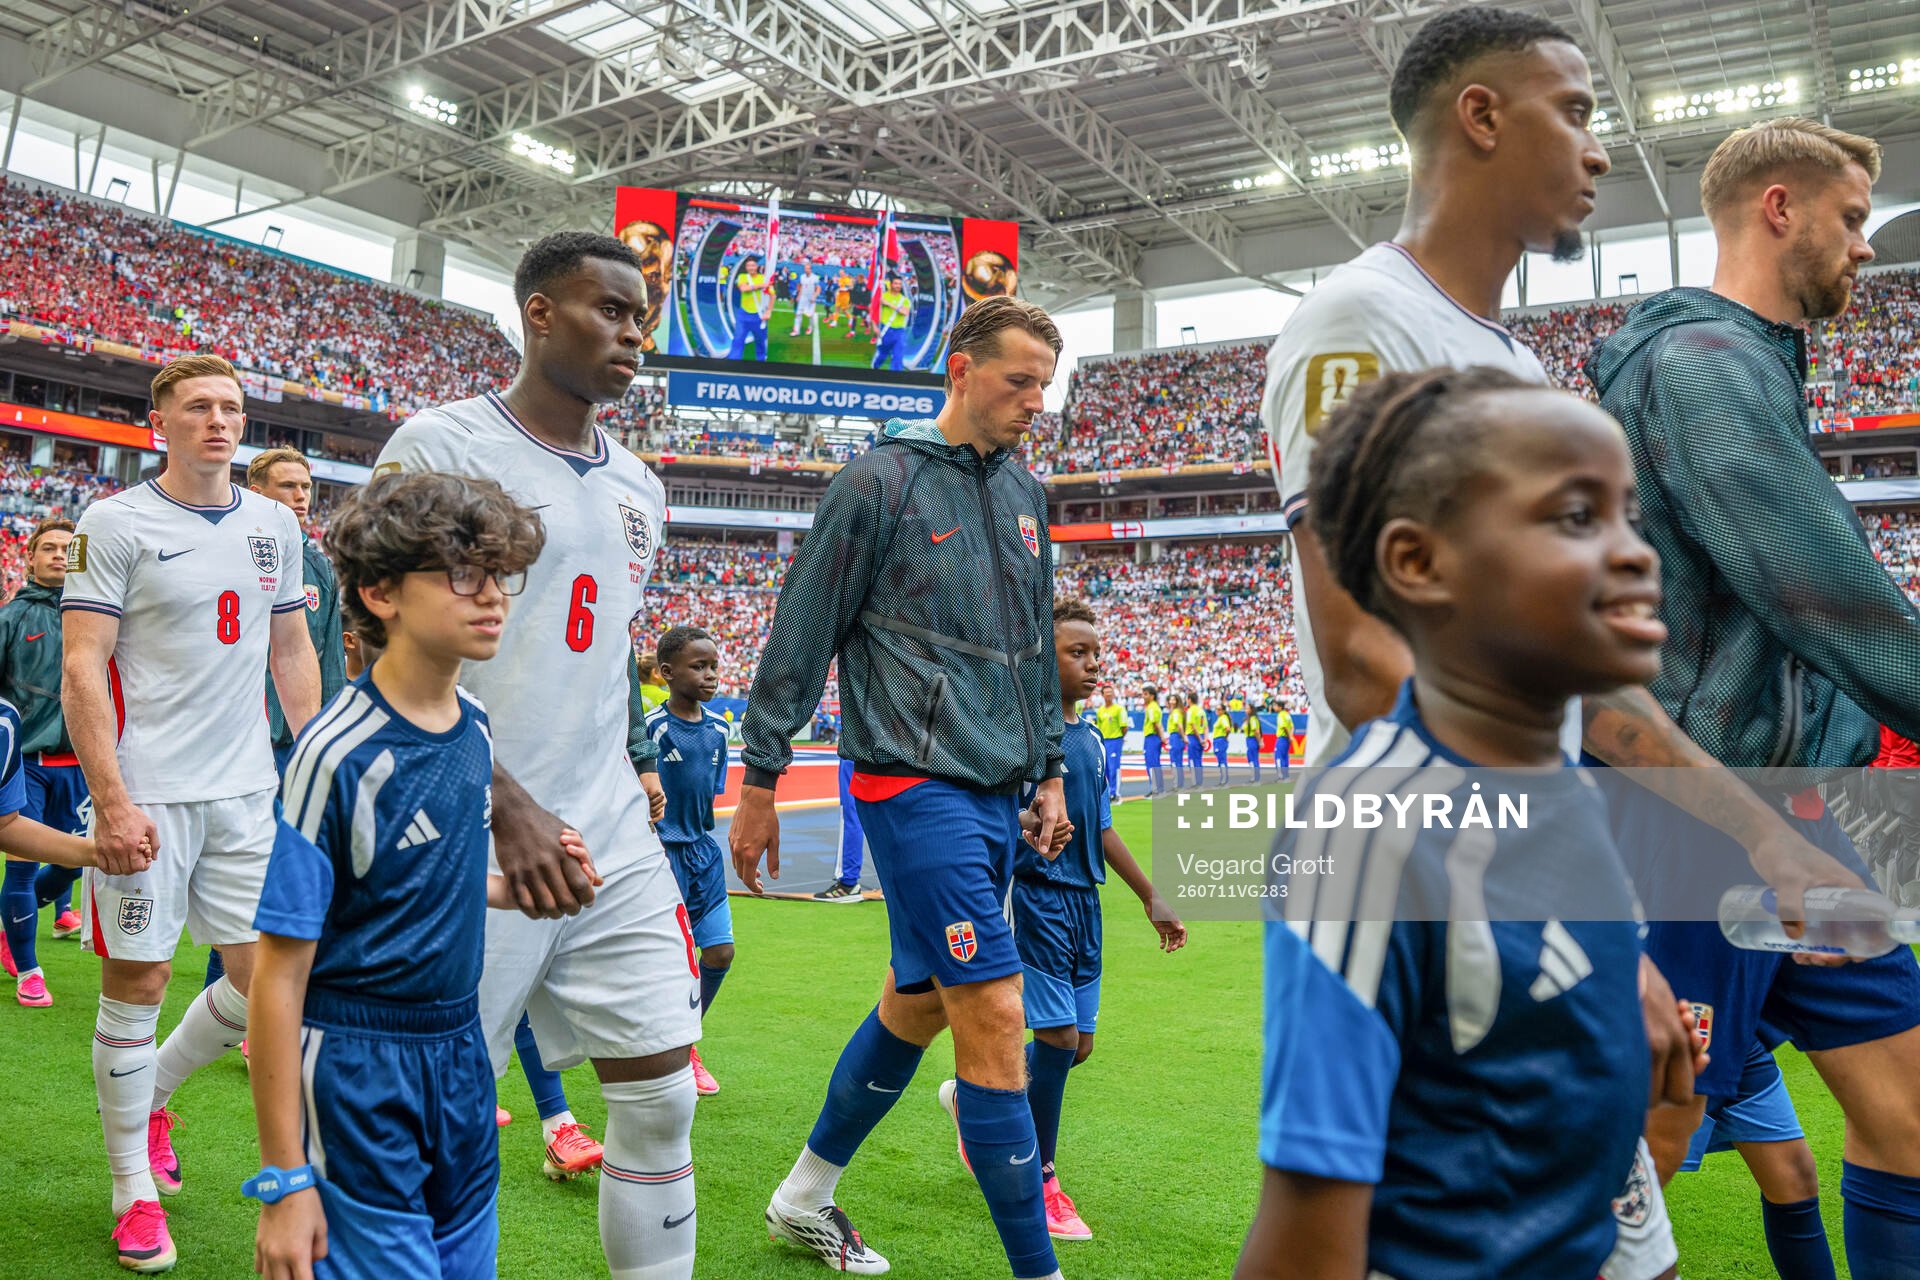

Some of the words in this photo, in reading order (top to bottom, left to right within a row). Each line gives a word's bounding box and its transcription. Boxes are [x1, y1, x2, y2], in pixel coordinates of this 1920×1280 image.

[696, 382, 742, 401] FIFA
[744, 385, 818, 406] WORLD
[820, 390, 861, 409] CUP
[863, 394, 934, 413] 2026
[217, 590, 240, 644] 8
[566, 574, 597, 652] 6
[258, 1180, 278, 1192] FIFA
